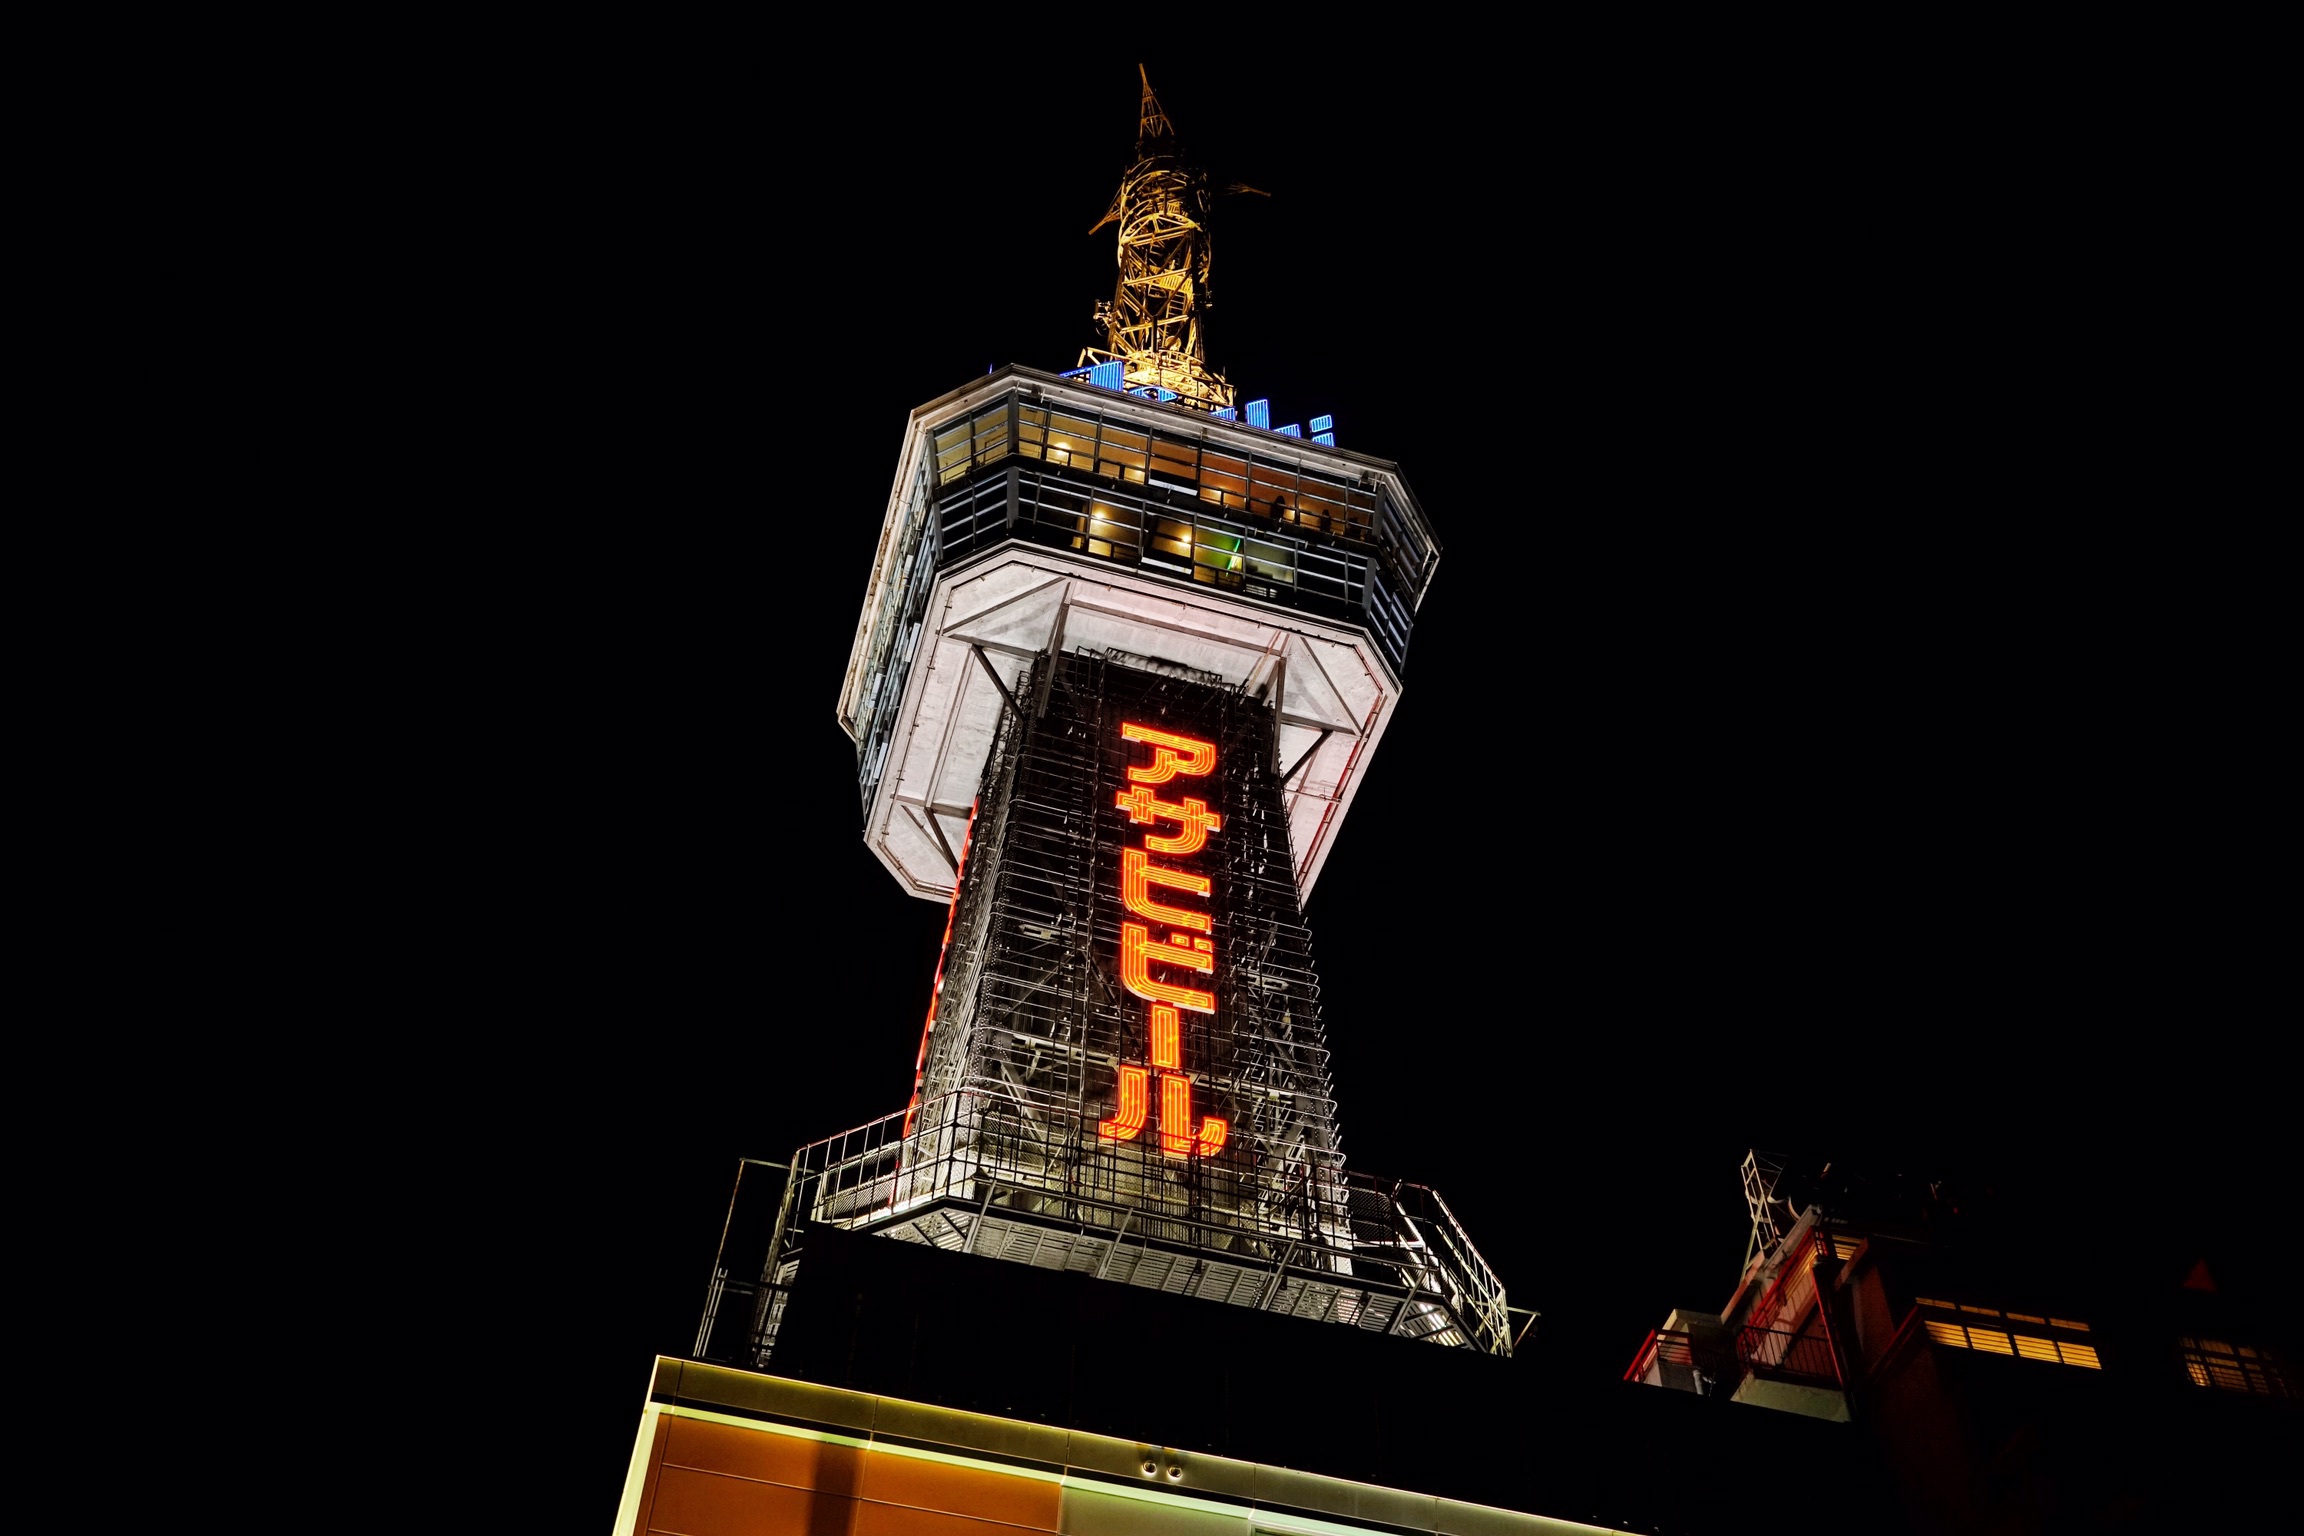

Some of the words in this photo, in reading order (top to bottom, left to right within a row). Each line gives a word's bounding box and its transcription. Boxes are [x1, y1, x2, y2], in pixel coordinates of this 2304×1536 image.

[1098, 721, 1228, 1159] アサヒビール
